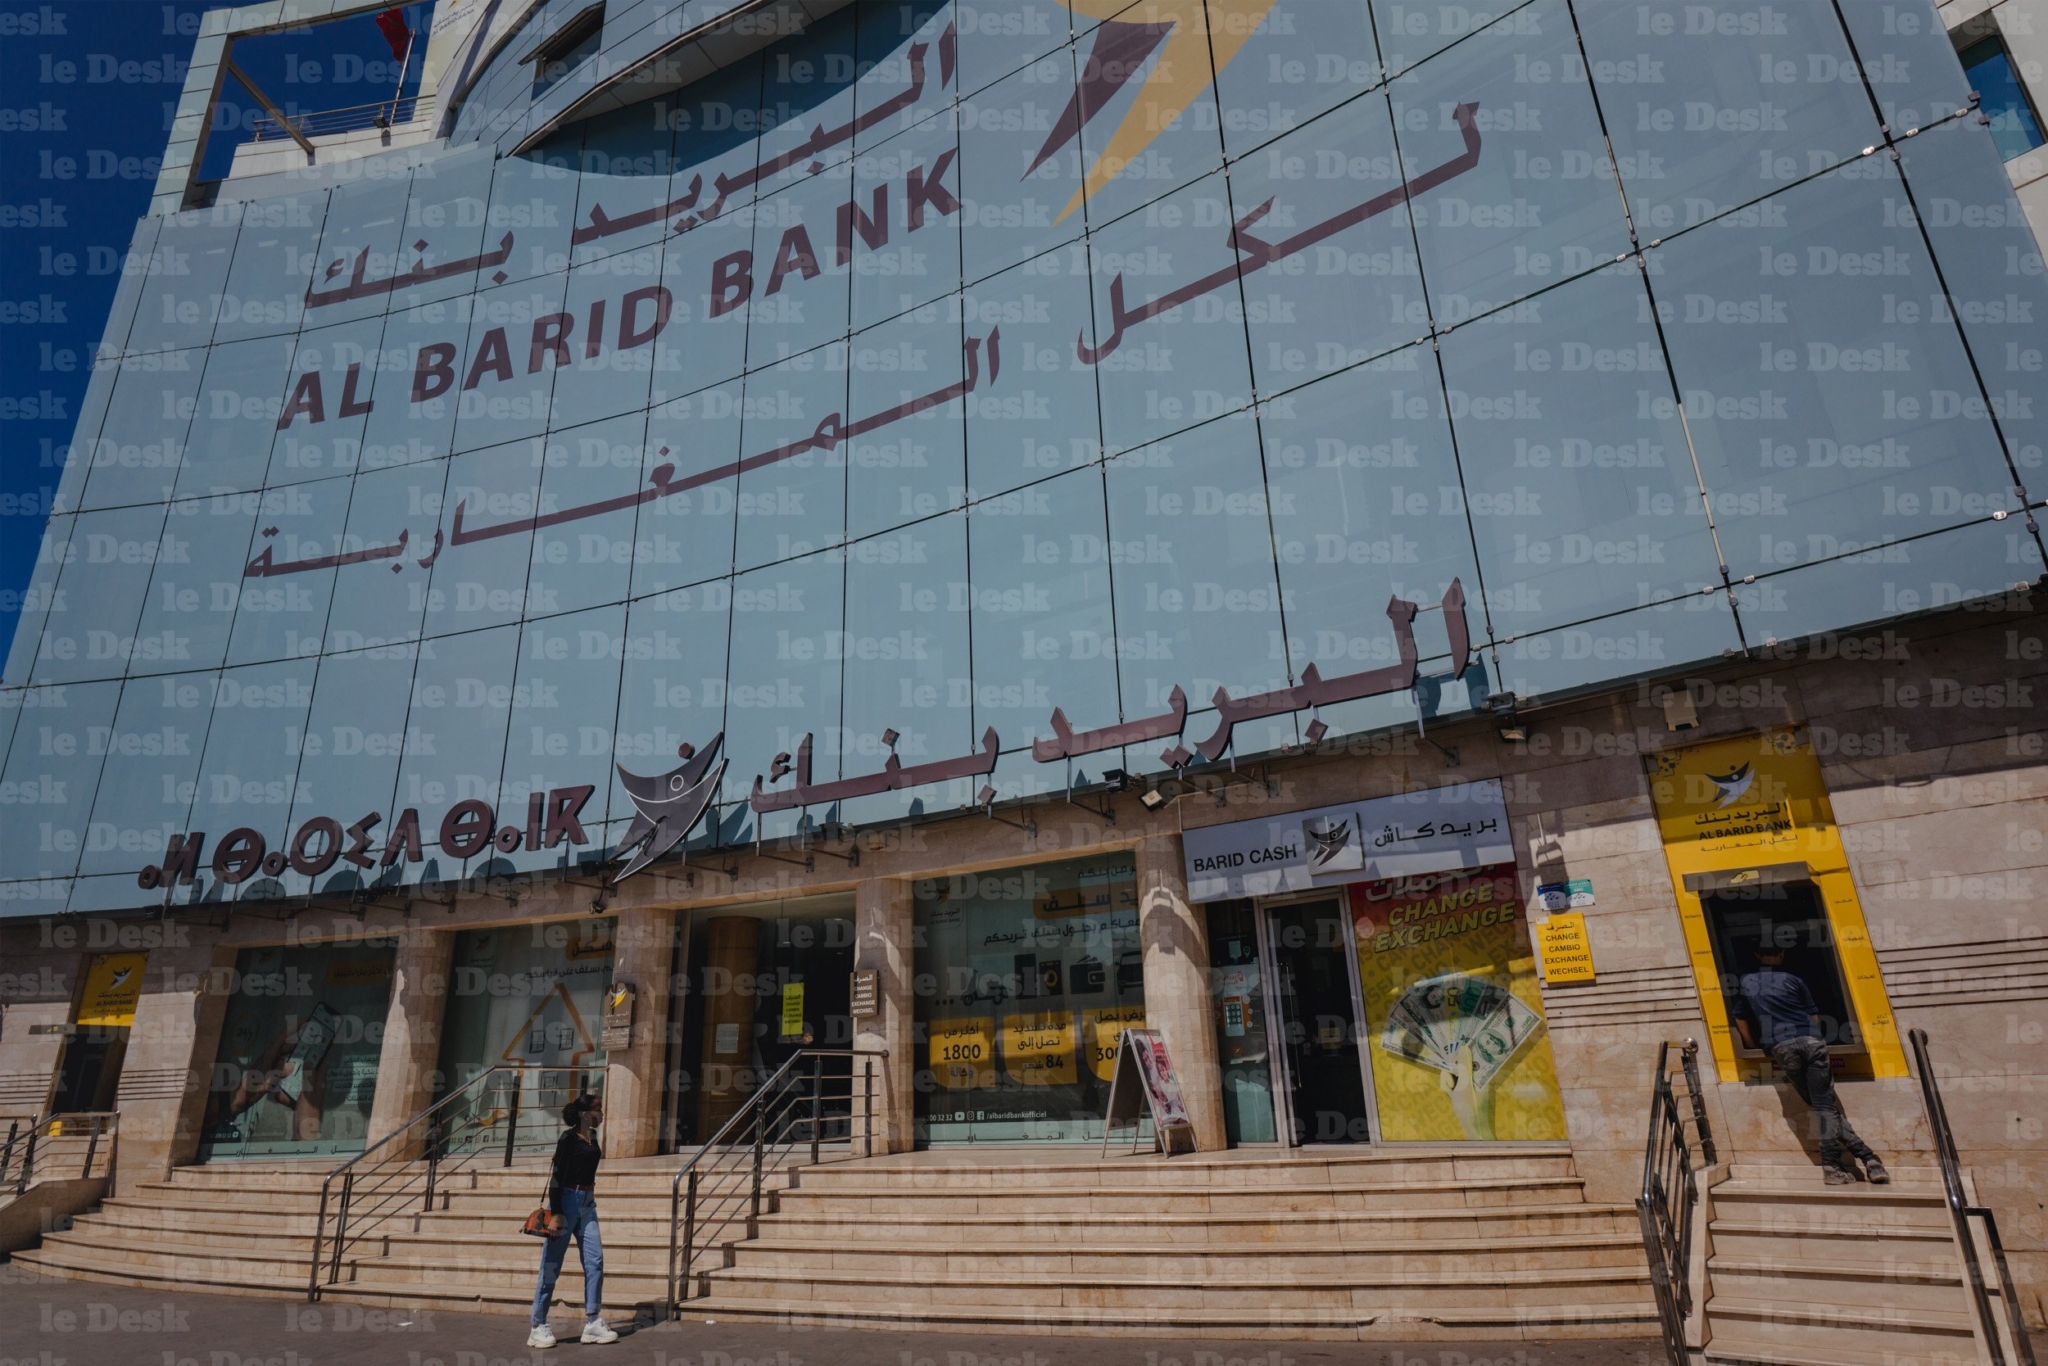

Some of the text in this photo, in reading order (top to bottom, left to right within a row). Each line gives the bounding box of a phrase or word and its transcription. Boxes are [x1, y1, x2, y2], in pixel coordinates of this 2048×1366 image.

[573, 20, 955, 245] البريد
[277, 146, 964, 430] AL BARID BANK
[244, 324, 1000, 578] المغاربة
[1032, 576, 1470, 771] البريد
[1441, 817, 1498, 837] بريد
[1699, 819, 1793, 841] AL BARID BANK
[1193, 844, 1298, 873] BARID CASH
[1388, 882, 1495, 927] CHANGE
[1374, 902, 1517, 954] EXCHANGE
[1545, 932, 1580, 942] CHANGE
[1546, 921, 1575, 932] الصرف
[1548, 943, 1581, 953] CAMBIO
[1544, 954, 1590, 965] EXCHANGE
[1548, 966, 1590, 976] WECHSEL
[943, 1044, 981, 1061] 1800
[1045, 1054, 1064, 1070] 84
